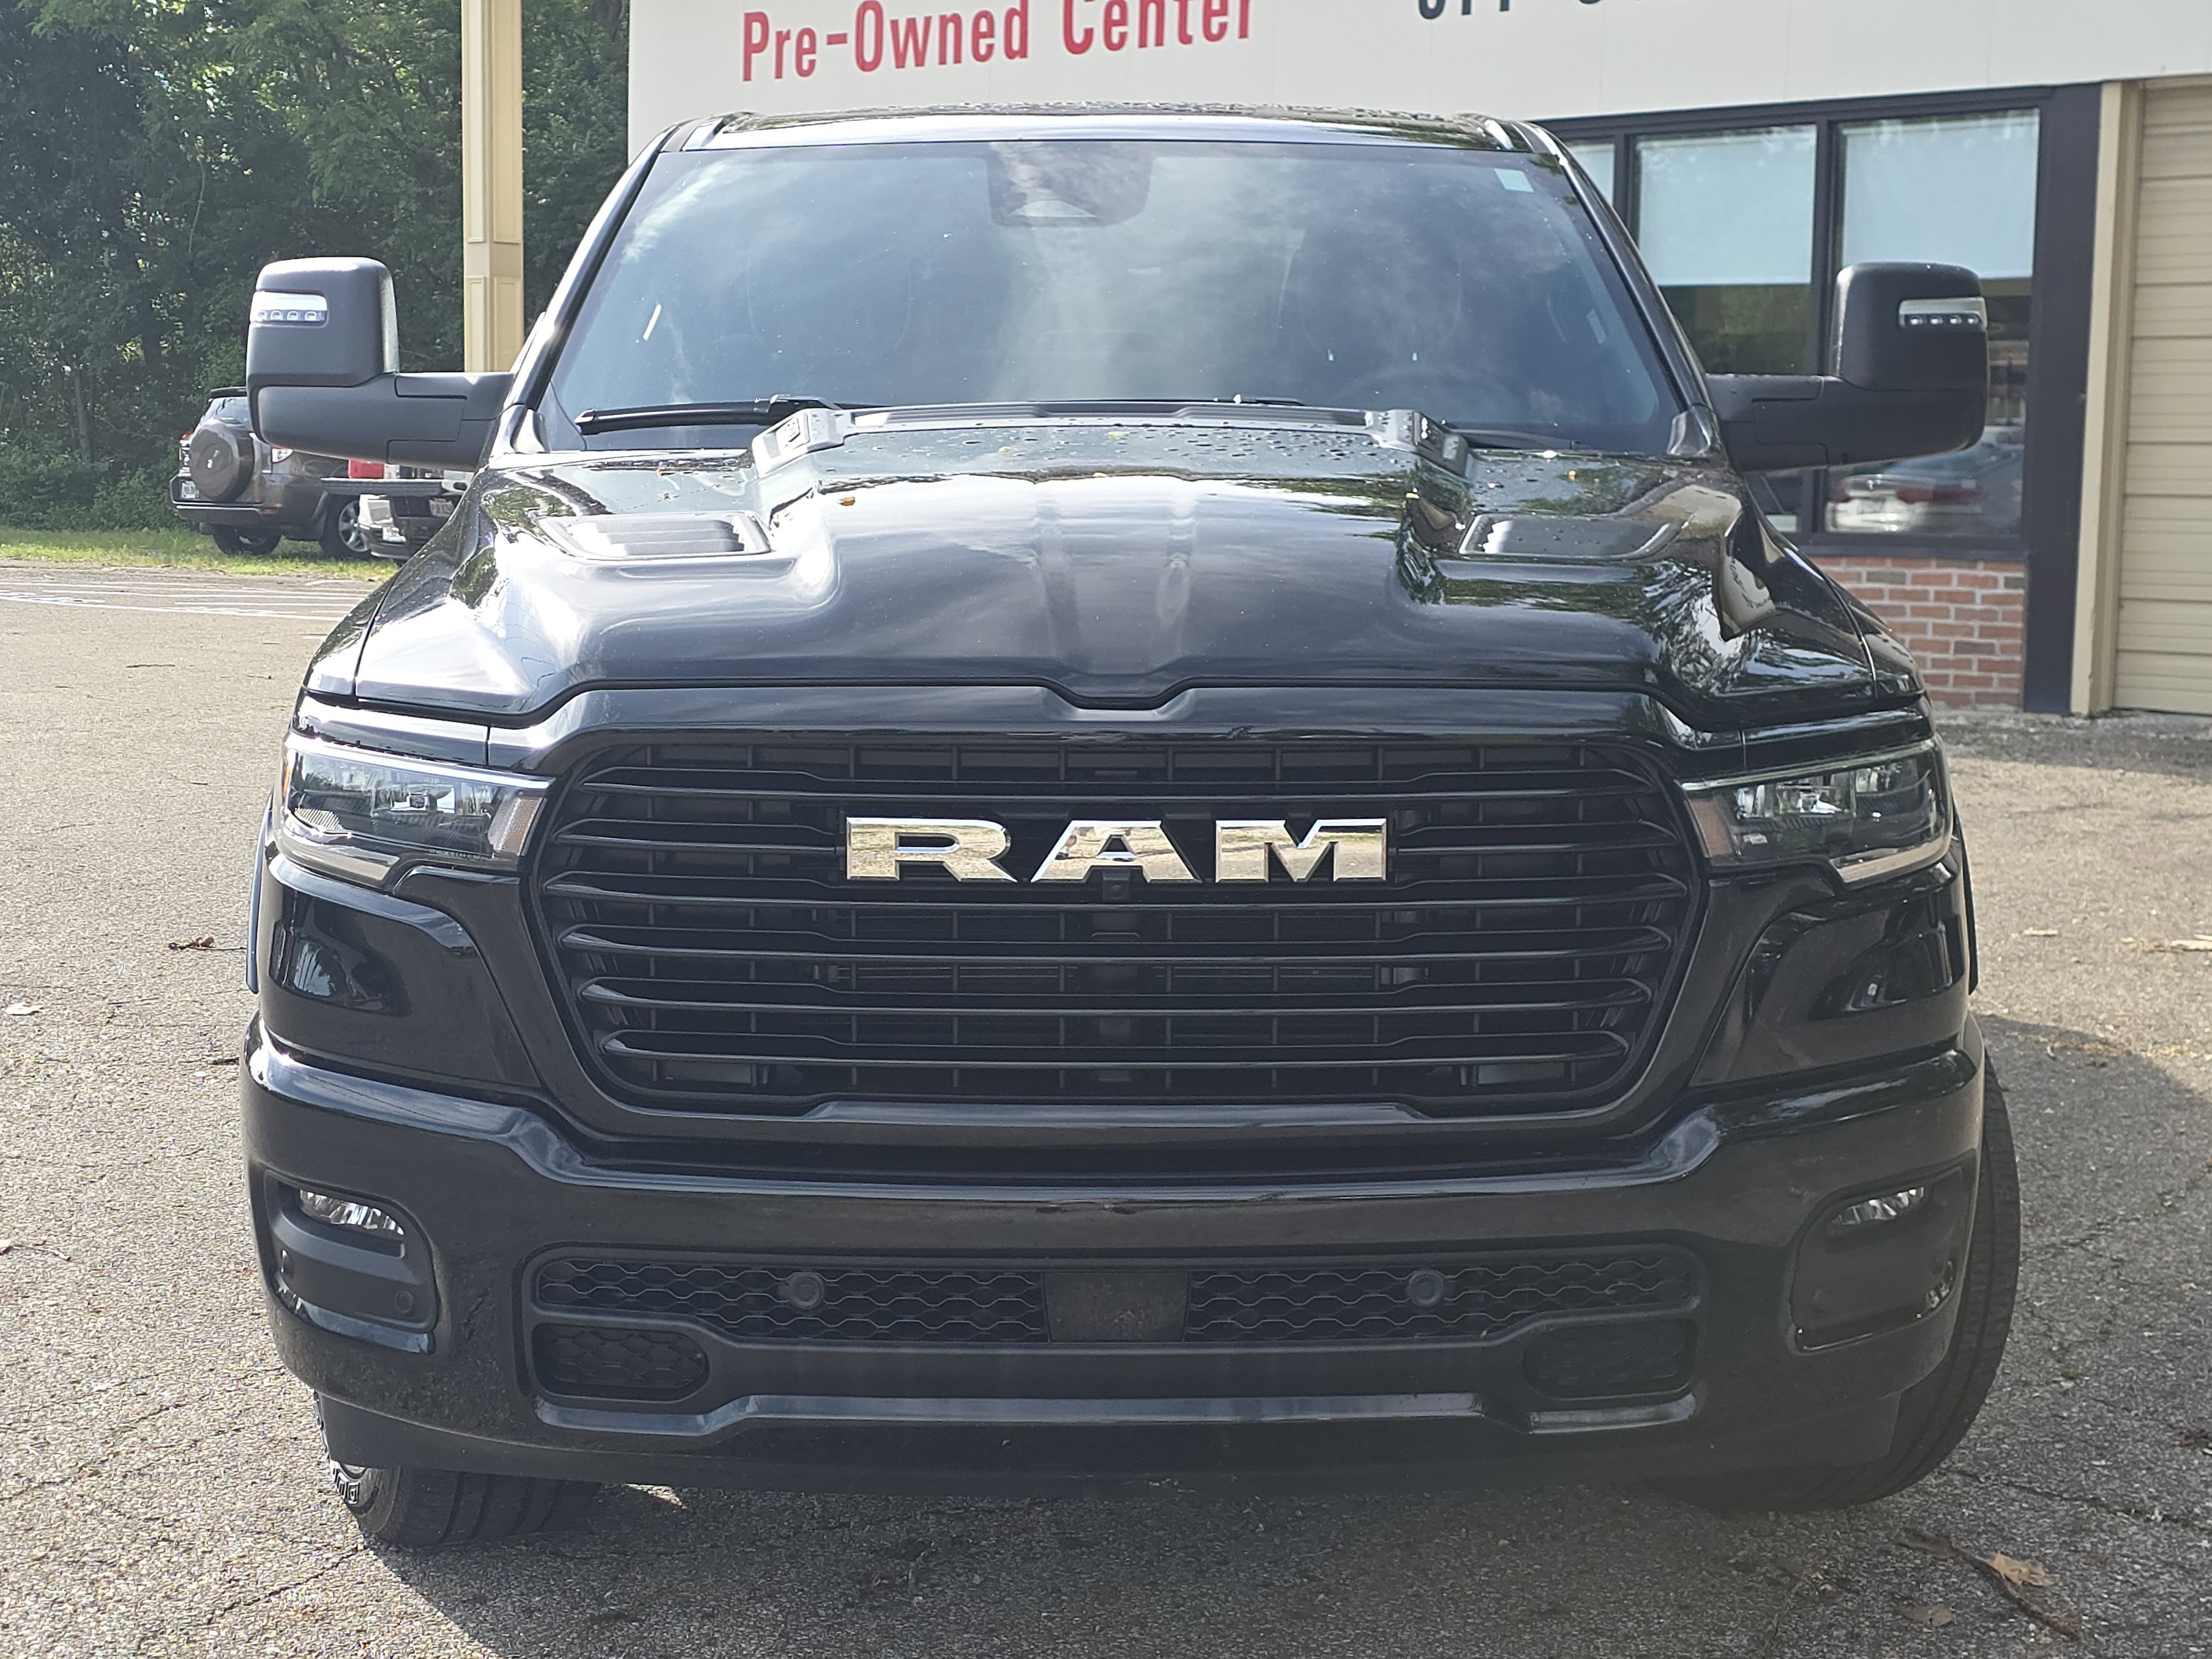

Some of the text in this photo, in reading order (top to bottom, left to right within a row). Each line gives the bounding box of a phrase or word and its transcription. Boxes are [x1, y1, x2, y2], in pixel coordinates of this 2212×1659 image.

[743, 0, 1250, 81] Pre-Owned Center
[847, 817, 1387, 883] RAM
